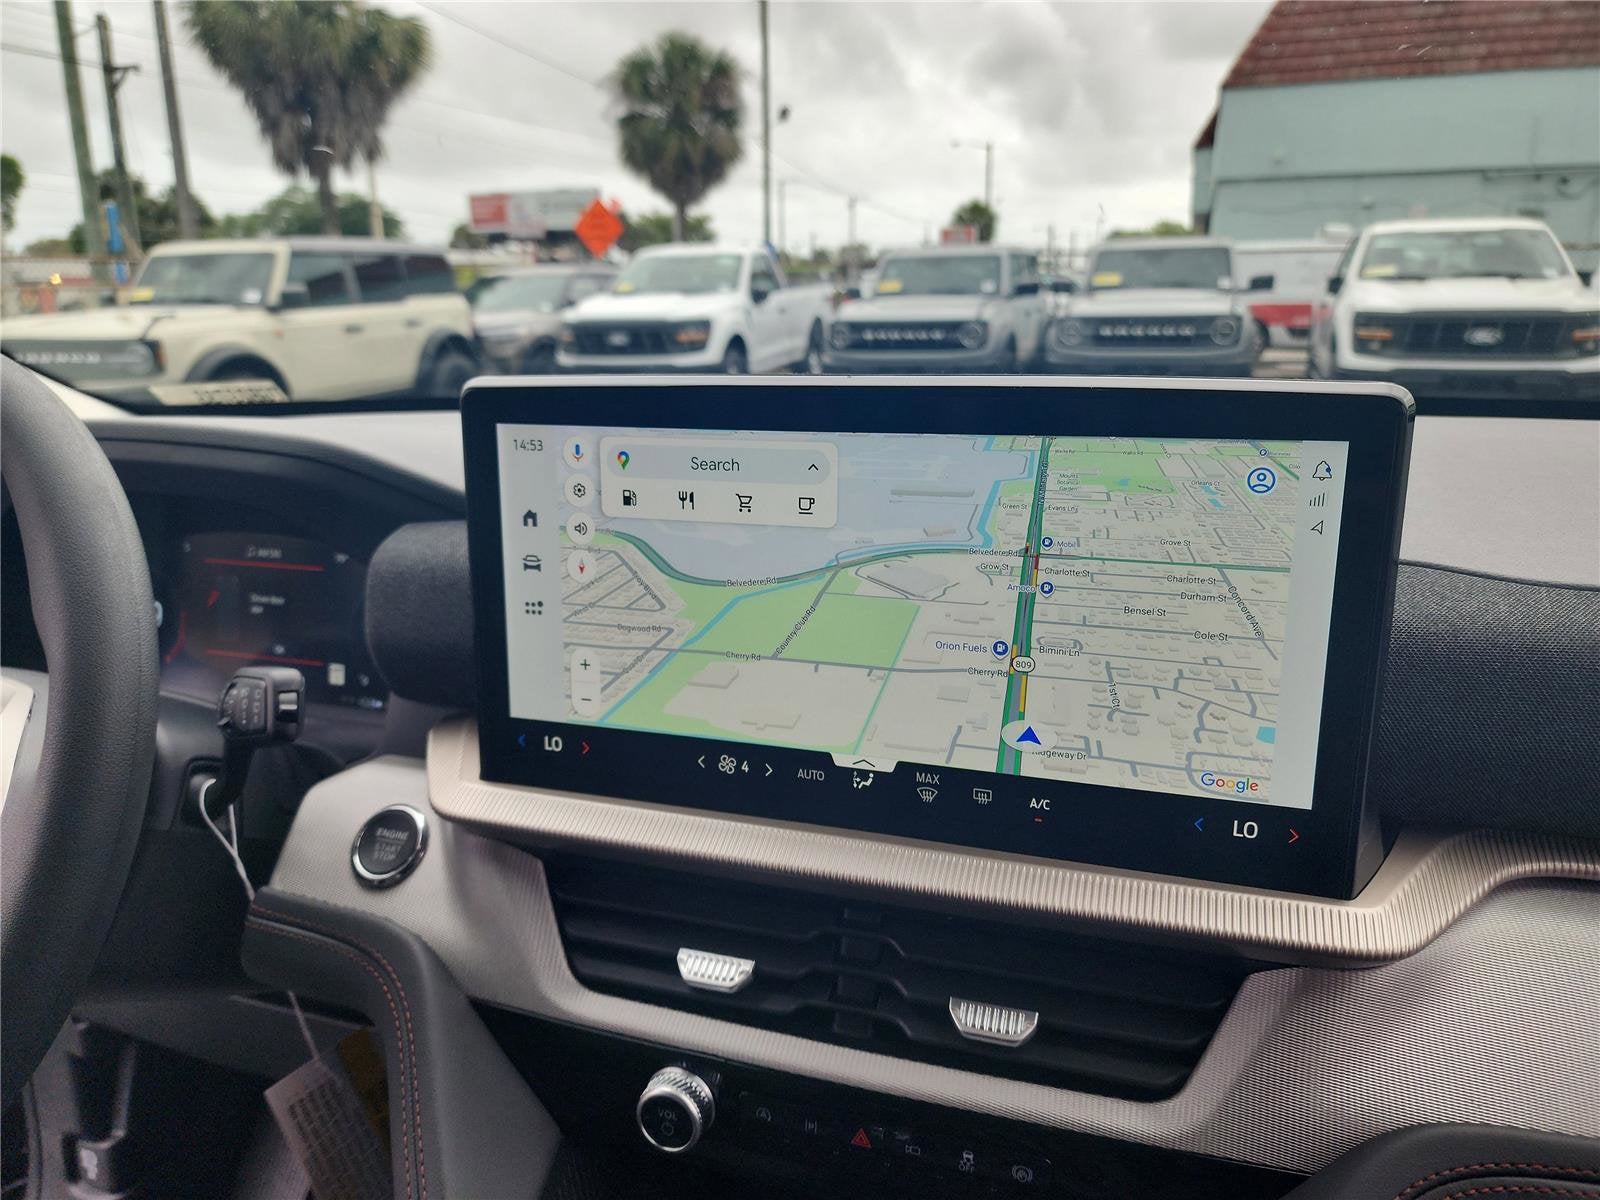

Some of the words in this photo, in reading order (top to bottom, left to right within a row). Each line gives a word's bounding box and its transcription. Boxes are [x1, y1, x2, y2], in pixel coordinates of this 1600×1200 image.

[513, 439, 544, 452] 14:53
[690, 456, 740, 472] Search
[1160, 538, 1181, 547] Grove
[969, 548, 1007, 556] Belvedere
[1044, 567, 1080, 576] Charlotte
[726, 578, 765, 587] Belvedere
[766, 577, 777, 585] Rd
[1166, 574, 1206, 585] Charlotte
[1207, 577, 1217, 585] St
[1007, 584, 1036, 592] Amoco
[1180, 592, 1216, 602] Durham
[1218, 594, 1227, 603] St
[1124, 606, 1155, 616] Bensel
[1157, 608, 1167, 617] St
[1228, 585, 1255, 621] Concord
[1251, 620, 1262, 638] Ave
[617, 623, 650, 634] Dogwood
[776, 630, 797, 655] Country
[795, 616, 808, 631] Club
[806, 606, 816, 616] Rd
[1194, 631, 1216, 641] Cole
[1218, 633, 1229, 642] St
[935, 640, 960, 651] Orion
[962, 643, 988, 654] Fuels
[1038, 646, 1066, 656] Bimini
[1068, 648, 1080, 657] Ln
[726, 651, 750, 661] Cherry
[752, 653, 761, 661] Rd
[1015, 660, 1032, 670] 809
[967, 667, 995, 679] Cherry
[996, 668, 1008, 678] Rd
[544, 736, 563, 752] LO
[1076, 752, 1088, 760] Dr
[741, 760, 750, 772] 4
[797, 768, 825, 782] AUTO
[916, 772, 940, 785] MAX
[1200, 772, 1258, 794] Google
[1030, 798, 1050, 810] A/C
[376, 827, 410, 841] ENGINE
[1232, 820, 1259, 839] LO
[658, 1106, 678, 1121] VOL
